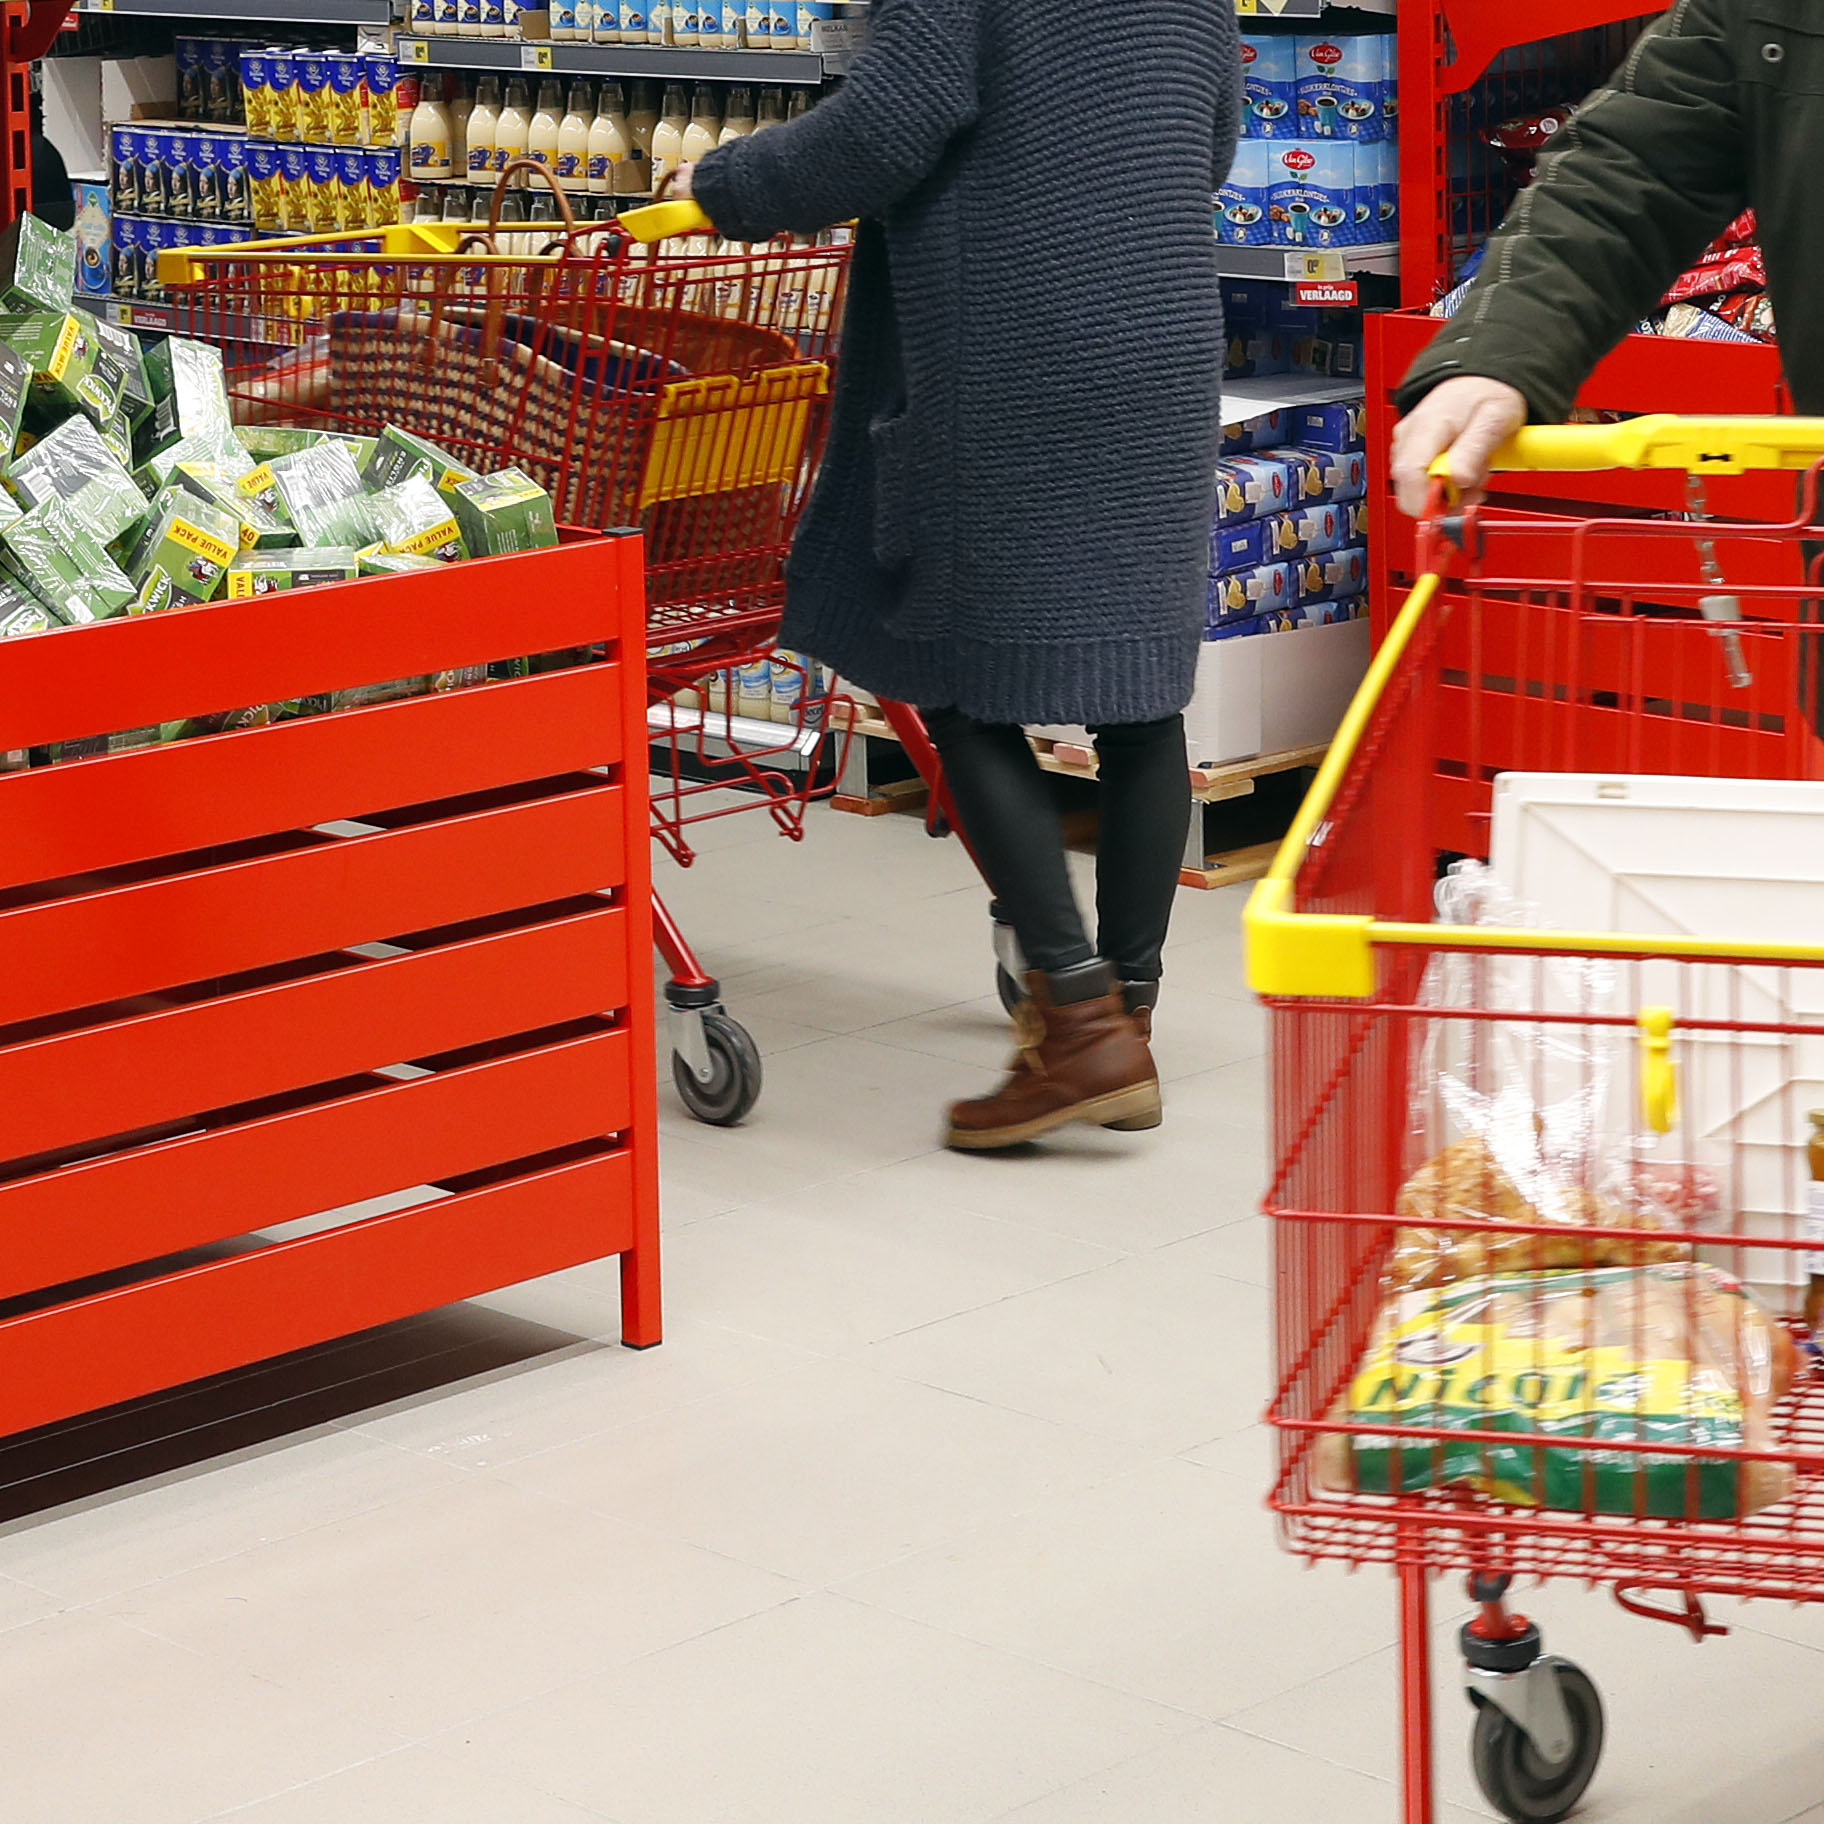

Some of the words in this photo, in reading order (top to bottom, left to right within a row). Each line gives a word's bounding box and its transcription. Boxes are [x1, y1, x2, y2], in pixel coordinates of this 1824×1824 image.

[1300, 289, 1353, 302] VERLAAGD
[172, 525, 204, 546] PACK
[204, 537, 235, 560] VALUE
